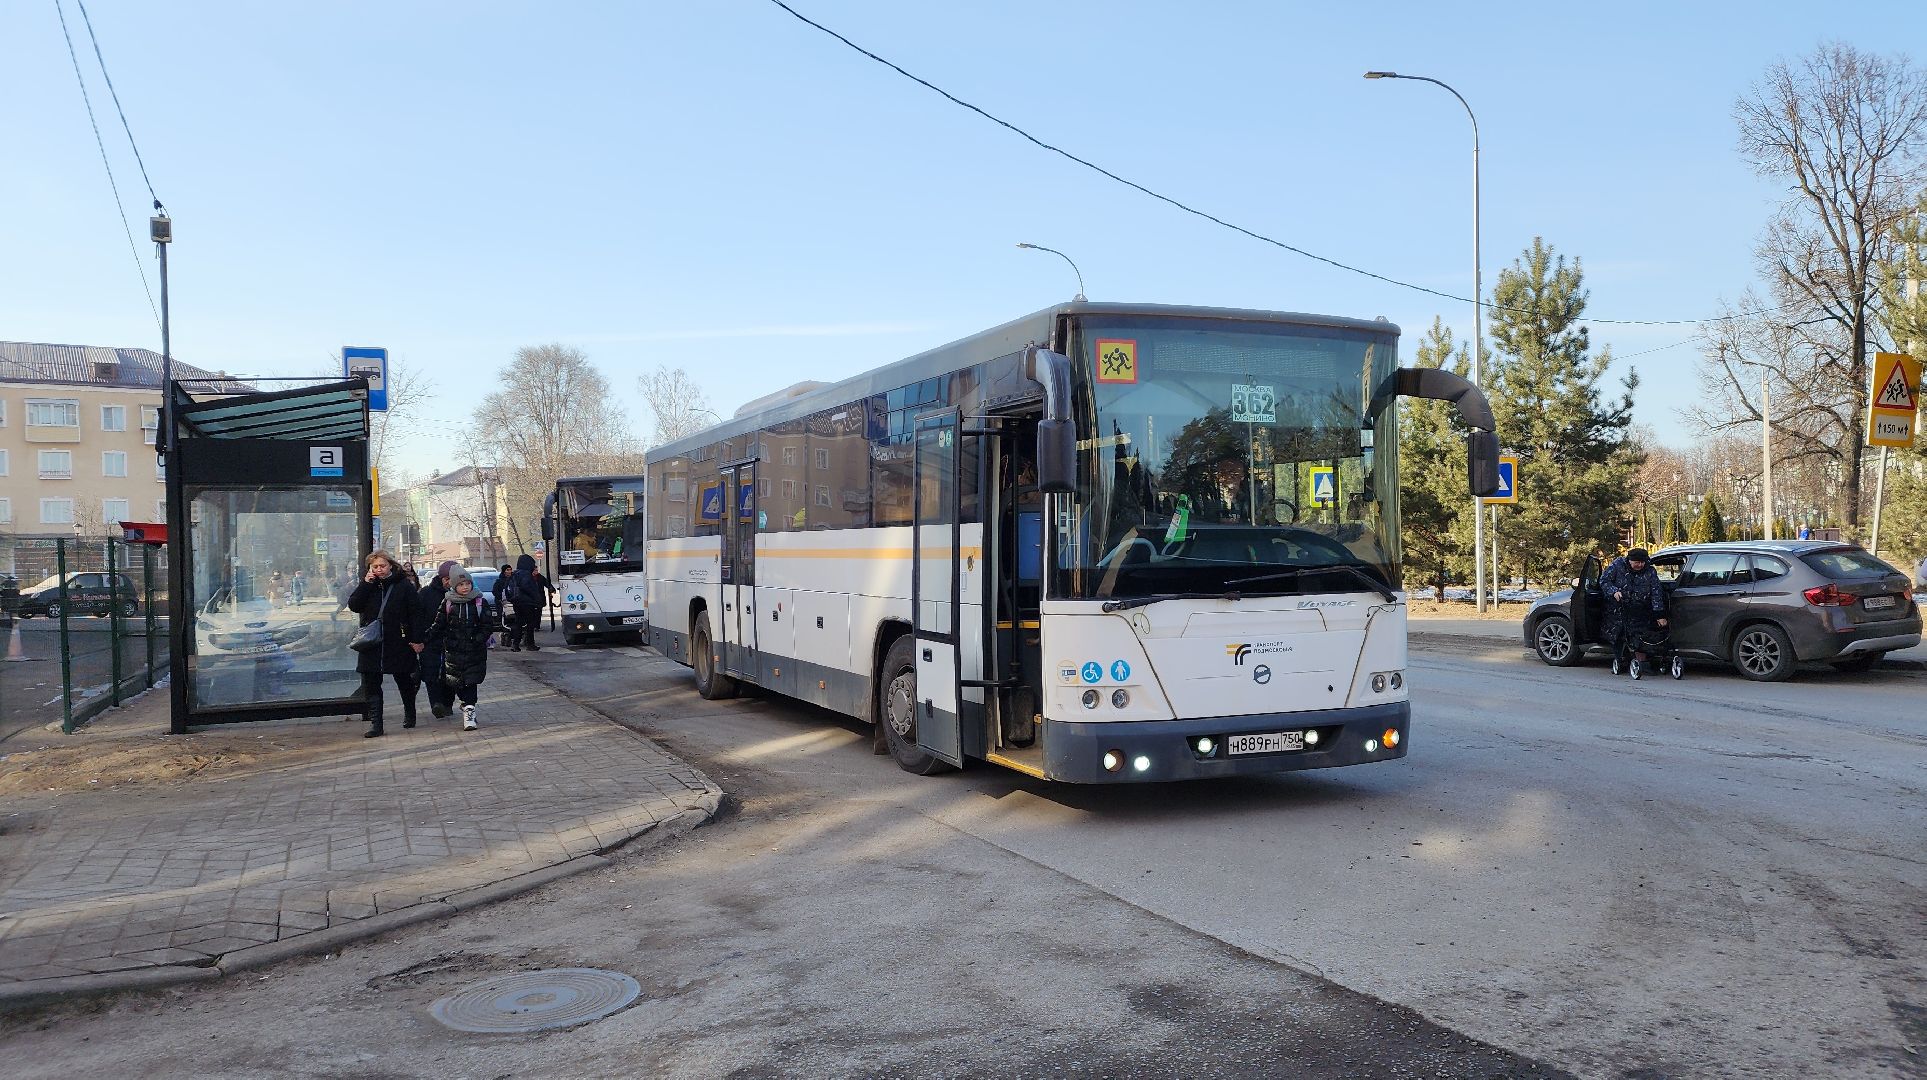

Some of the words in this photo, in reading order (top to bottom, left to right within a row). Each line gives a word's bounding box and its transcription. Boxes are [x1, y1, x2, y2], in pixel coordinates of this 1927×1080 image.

[1234, 385, 1272, 393] МОСКВА
[1233, 392, 1275, 415] 362
[1883, 424, 1896, 434] 150
